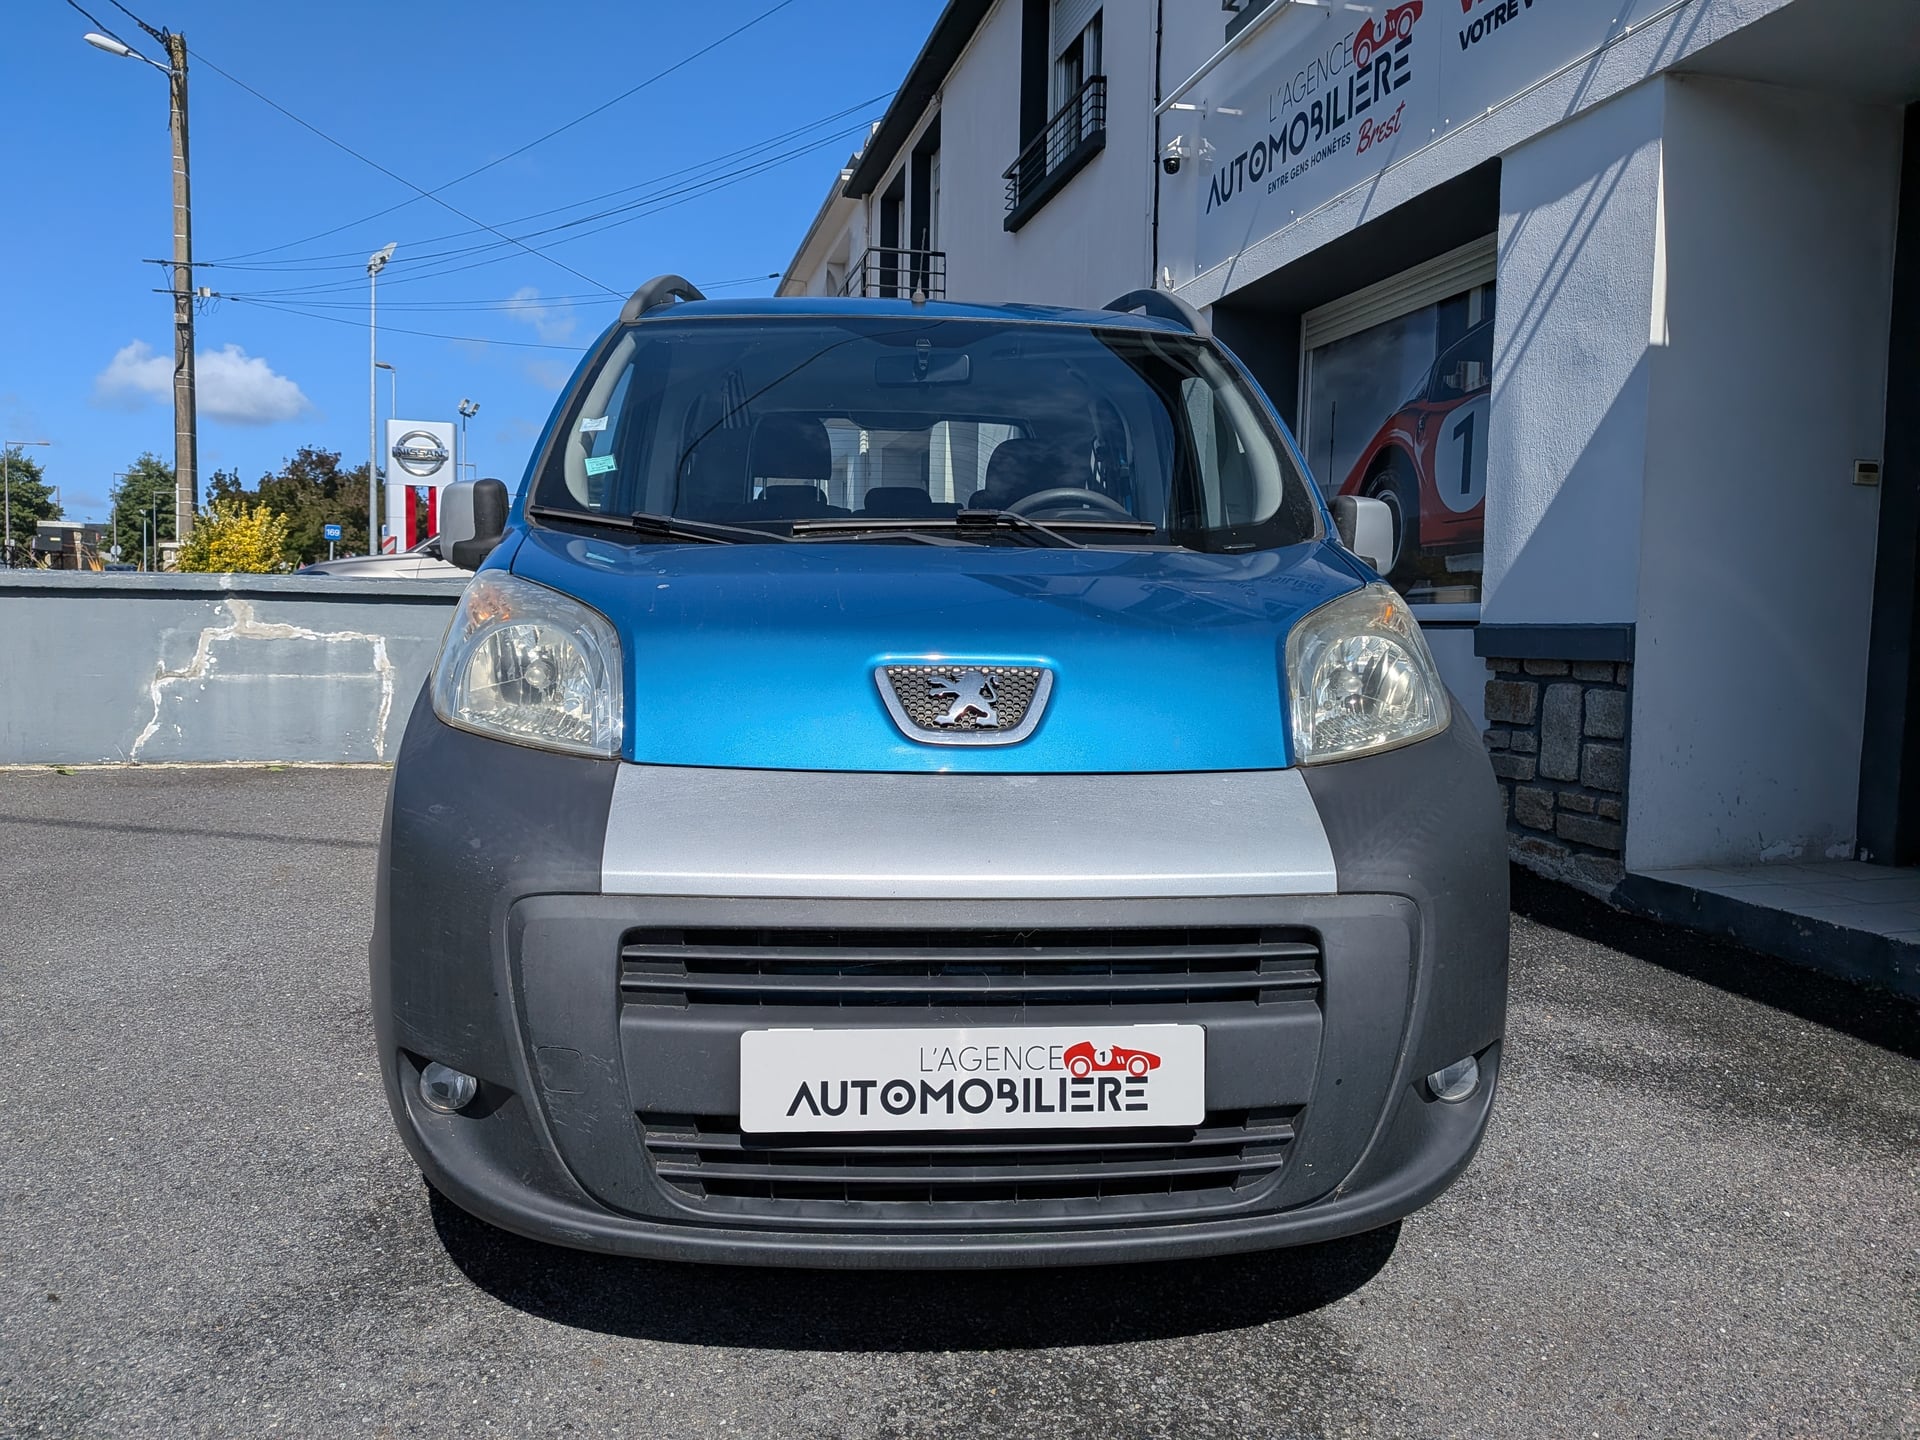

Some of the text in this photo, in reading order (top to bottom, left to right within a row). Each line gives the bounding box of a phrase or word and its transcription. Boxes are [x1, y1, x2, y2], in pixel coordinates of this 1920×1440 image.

[1459, 0, 1519, 51] VOTRE
[1269, 31, 1354, 123] L'AGENCE
[1356, 100, 1406, 156] Brest
[1267, 131, 1351, 195] ENTRE GENS HONNÊTES
[399, 448, 443, 458] NISSAN
[1453, 410, 1475, 495] 1
[326, 527, 340, 537] 169
[919, 1044, 1065, 1073] L'AGENCE
[1099, 1049, 1107, 1063] 1
[785, 1074, 1149, 1117] AUTOMOBILIERE
